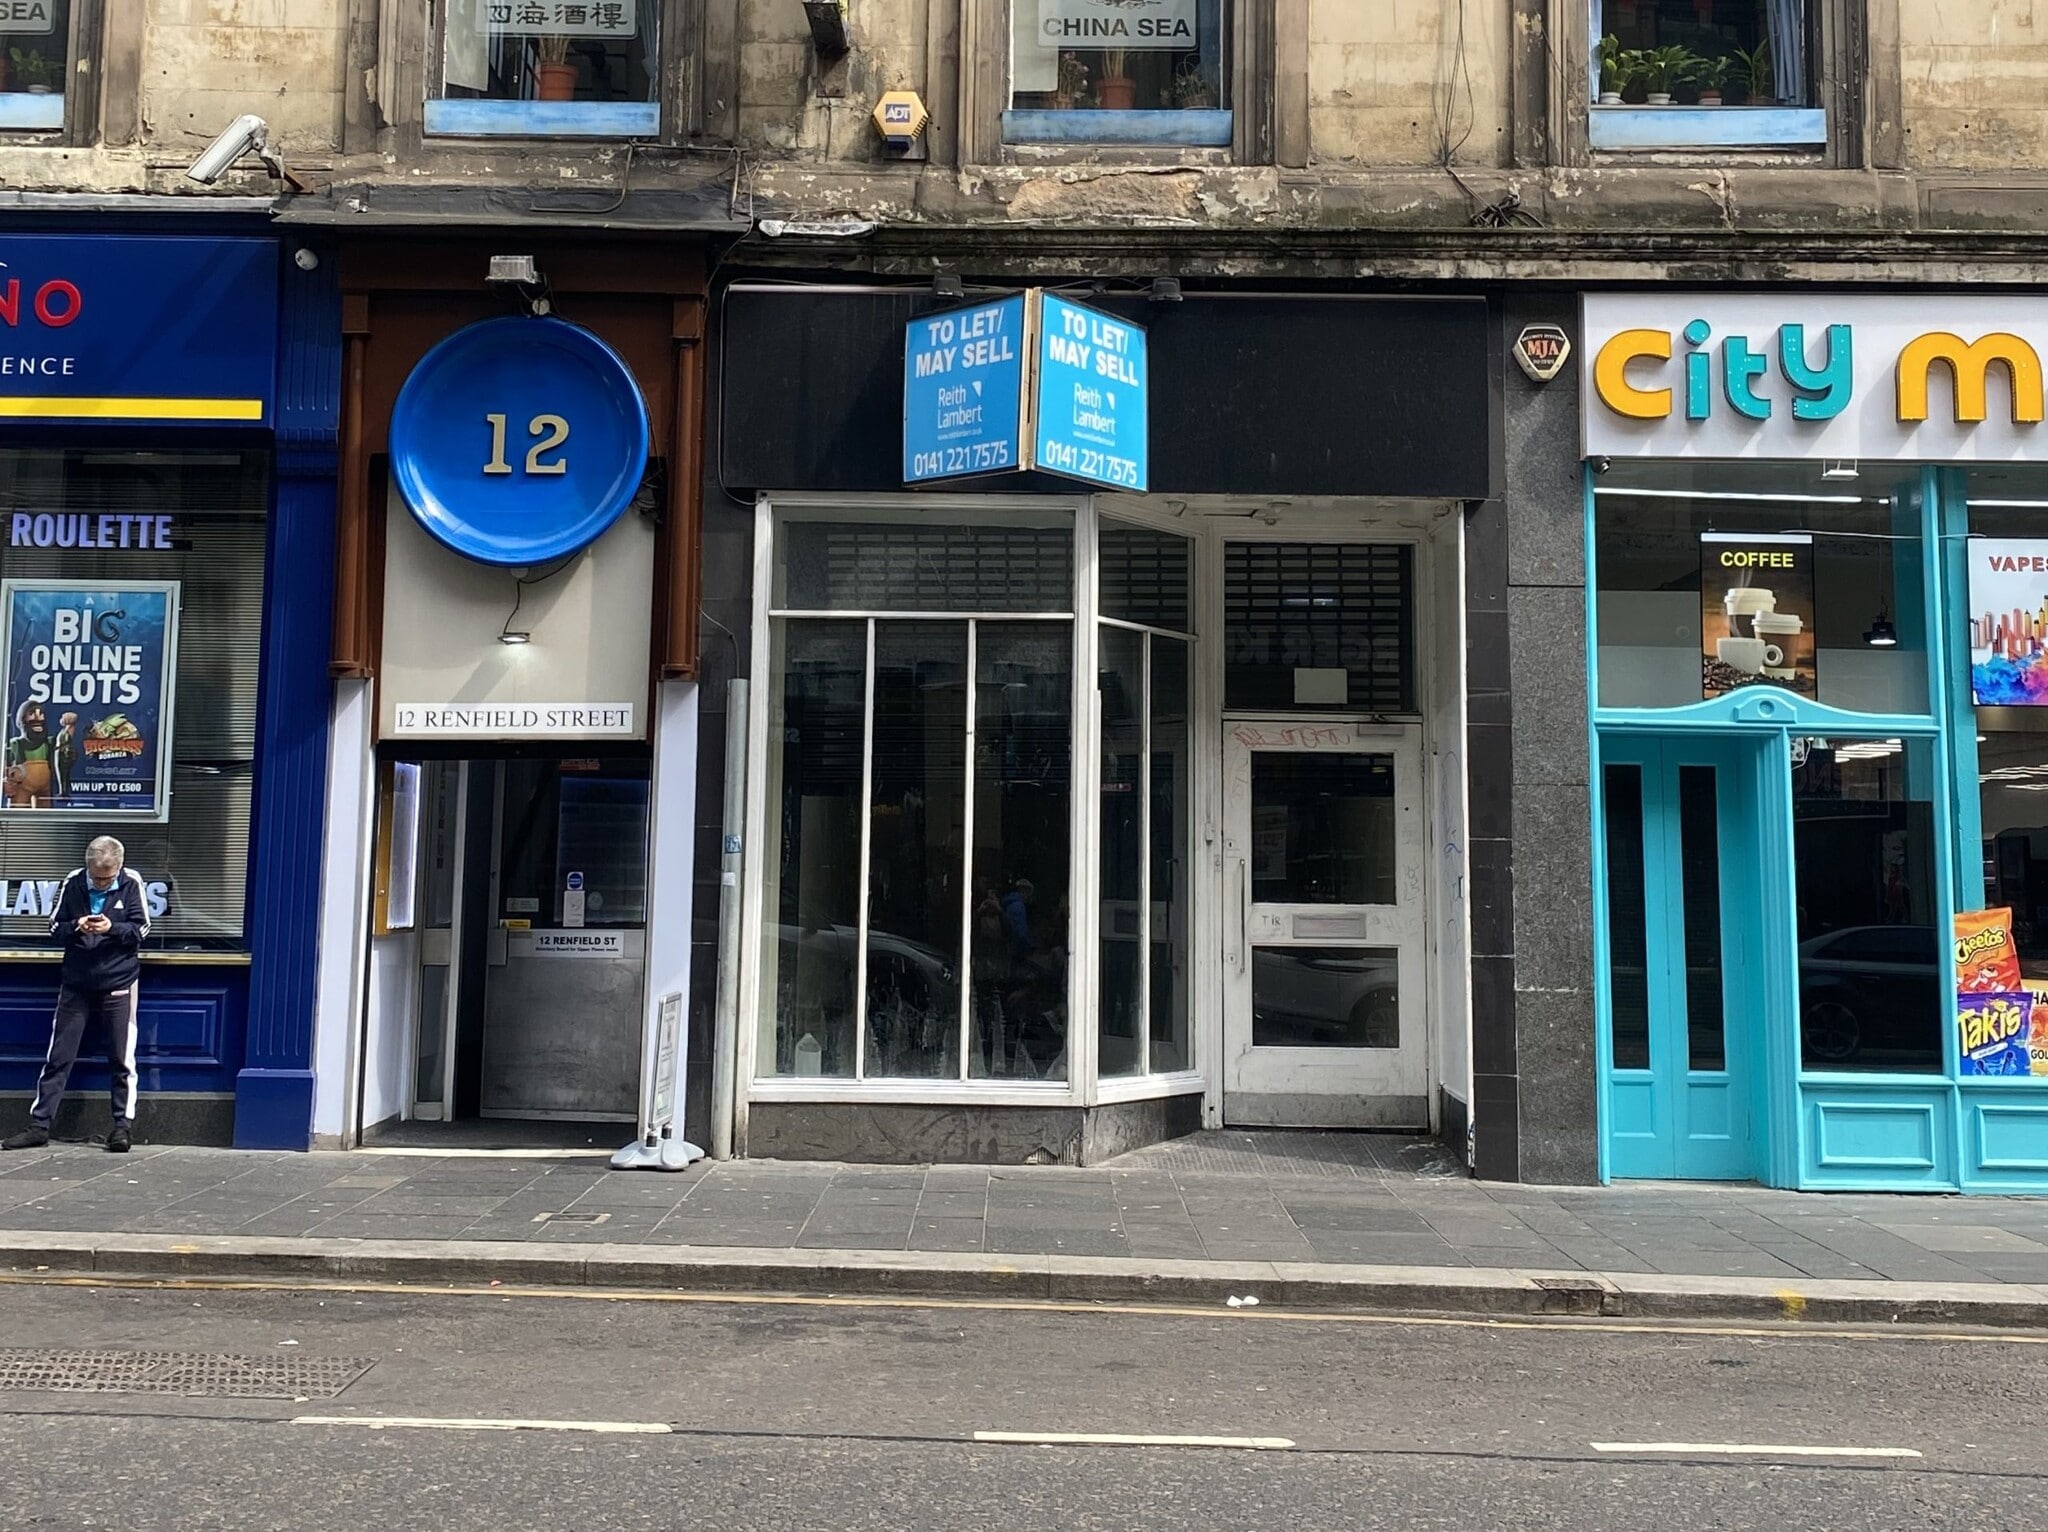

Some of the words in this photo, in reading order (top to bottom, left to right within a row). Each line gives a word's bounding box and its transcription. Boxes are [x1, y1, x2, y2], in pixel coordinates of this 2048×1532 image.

[0, 2, 47, 20] SEA
[487, 2, 629, 30] 四海酒樓
[1043, 18, 1129, 37] CHINA
[1137, 18, 1192, 37] SEA
[886, 105, 910, 121] ADT
[928, 319, 954, 347] TO
[960, 307, 1005, 341] LET/
[1061, 308, 1087, 340] TO
[1092, 319, 1129, 354] LET/
[916, 347, 957, 379] MAY
[962, 336, 1013, 369] SELL
[1049, 335, 1091, 371] MAY
[1095, 352, 1139, 387] SELL
[1527, 340, 1559, 359] MJA
[1, 357, 75, 375] ENCE
[1593, 318, 1854, 422] city
[938, 384, 967, 408] Reith
[1073, 382, 1102, 409] Reith
[937, 403, 983, 430] Lambert
[1073, 404, 1116, 436] Lambert
[483, 414, 570, 474] 12
[914, 449, 944, 477] 0141
[946, 445, 971, 471] 221
[973, 440, 1008, 467] 7575
[1046, 440, 1078, 469] 0141
[1079, 449, 1105, 476] 221
[1106, 456, 1138, 485] 7575
[11, 513, 174, 548] ROULETTE
[1720, 551, 1794, 568] COFFEE
[1988, 556, 2048, 572] VAPE
[54, 609, 126, 643] BIG
[31, 645, 142, 672] ONLINE
[28, 672, 141, 704] SLOTS
[397, 711, 415, 728] 12
[425, 710, 538, 728] RENFIELD
[546, 709, 629, 727] STREET
[71, 782, 90, 792] WIN
[91, 783, 104, 792] UP
[106, 783, 118, 792] TO
[119, 783, 142, 792] £500
[540, 936, 551, 945] 12
[553, 936, 601, 945] RENFIELD
[604, 936, 617, 946] ST
[1955, 928, 2005, 963] Cheetos
[1958, 1001, 2021, 1057] Takis
